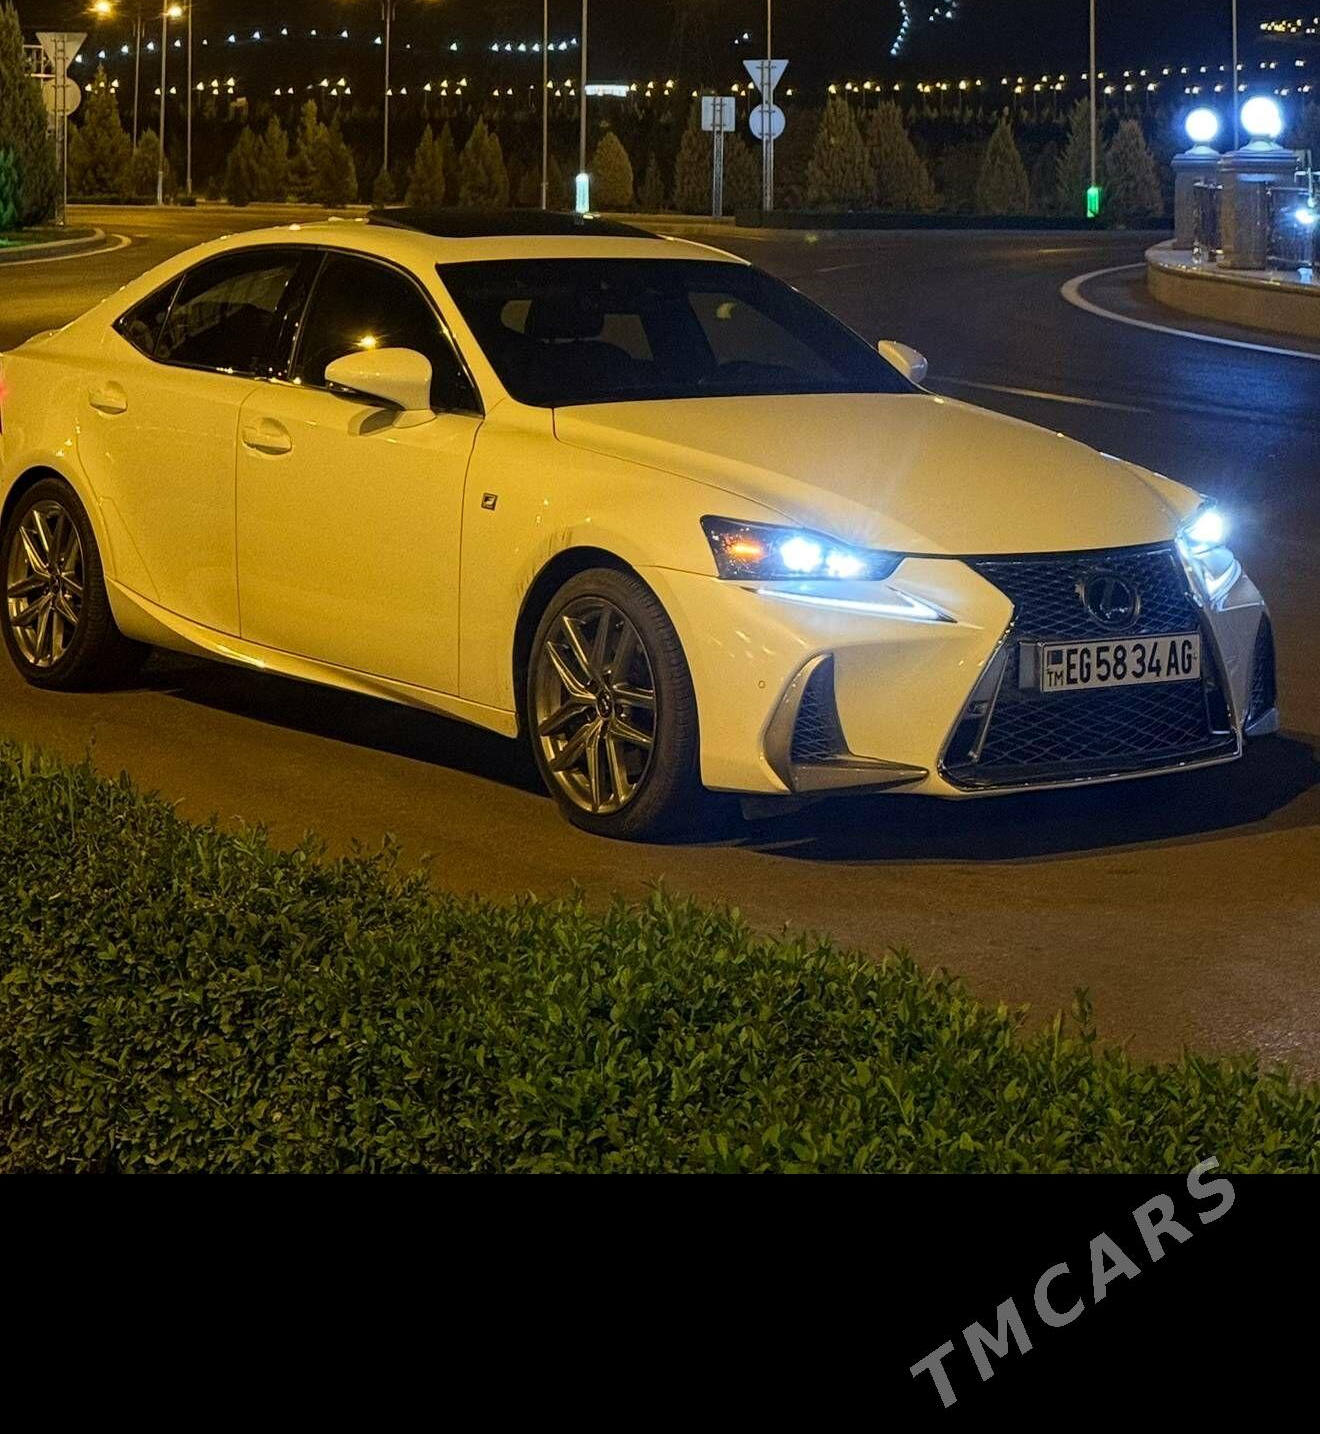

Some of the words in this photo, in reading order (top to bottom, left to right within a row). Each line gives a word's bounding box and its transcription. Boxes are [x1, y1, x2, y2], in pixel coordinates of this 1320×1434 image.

[1066, 647, 1091, 685] EG
[1096, 645, 1127, 681] 58
[1131, 642, 1162, 678] 34
[1166, 639, 1192, 676] AG
[1047, 670, 1064, 687] TM
